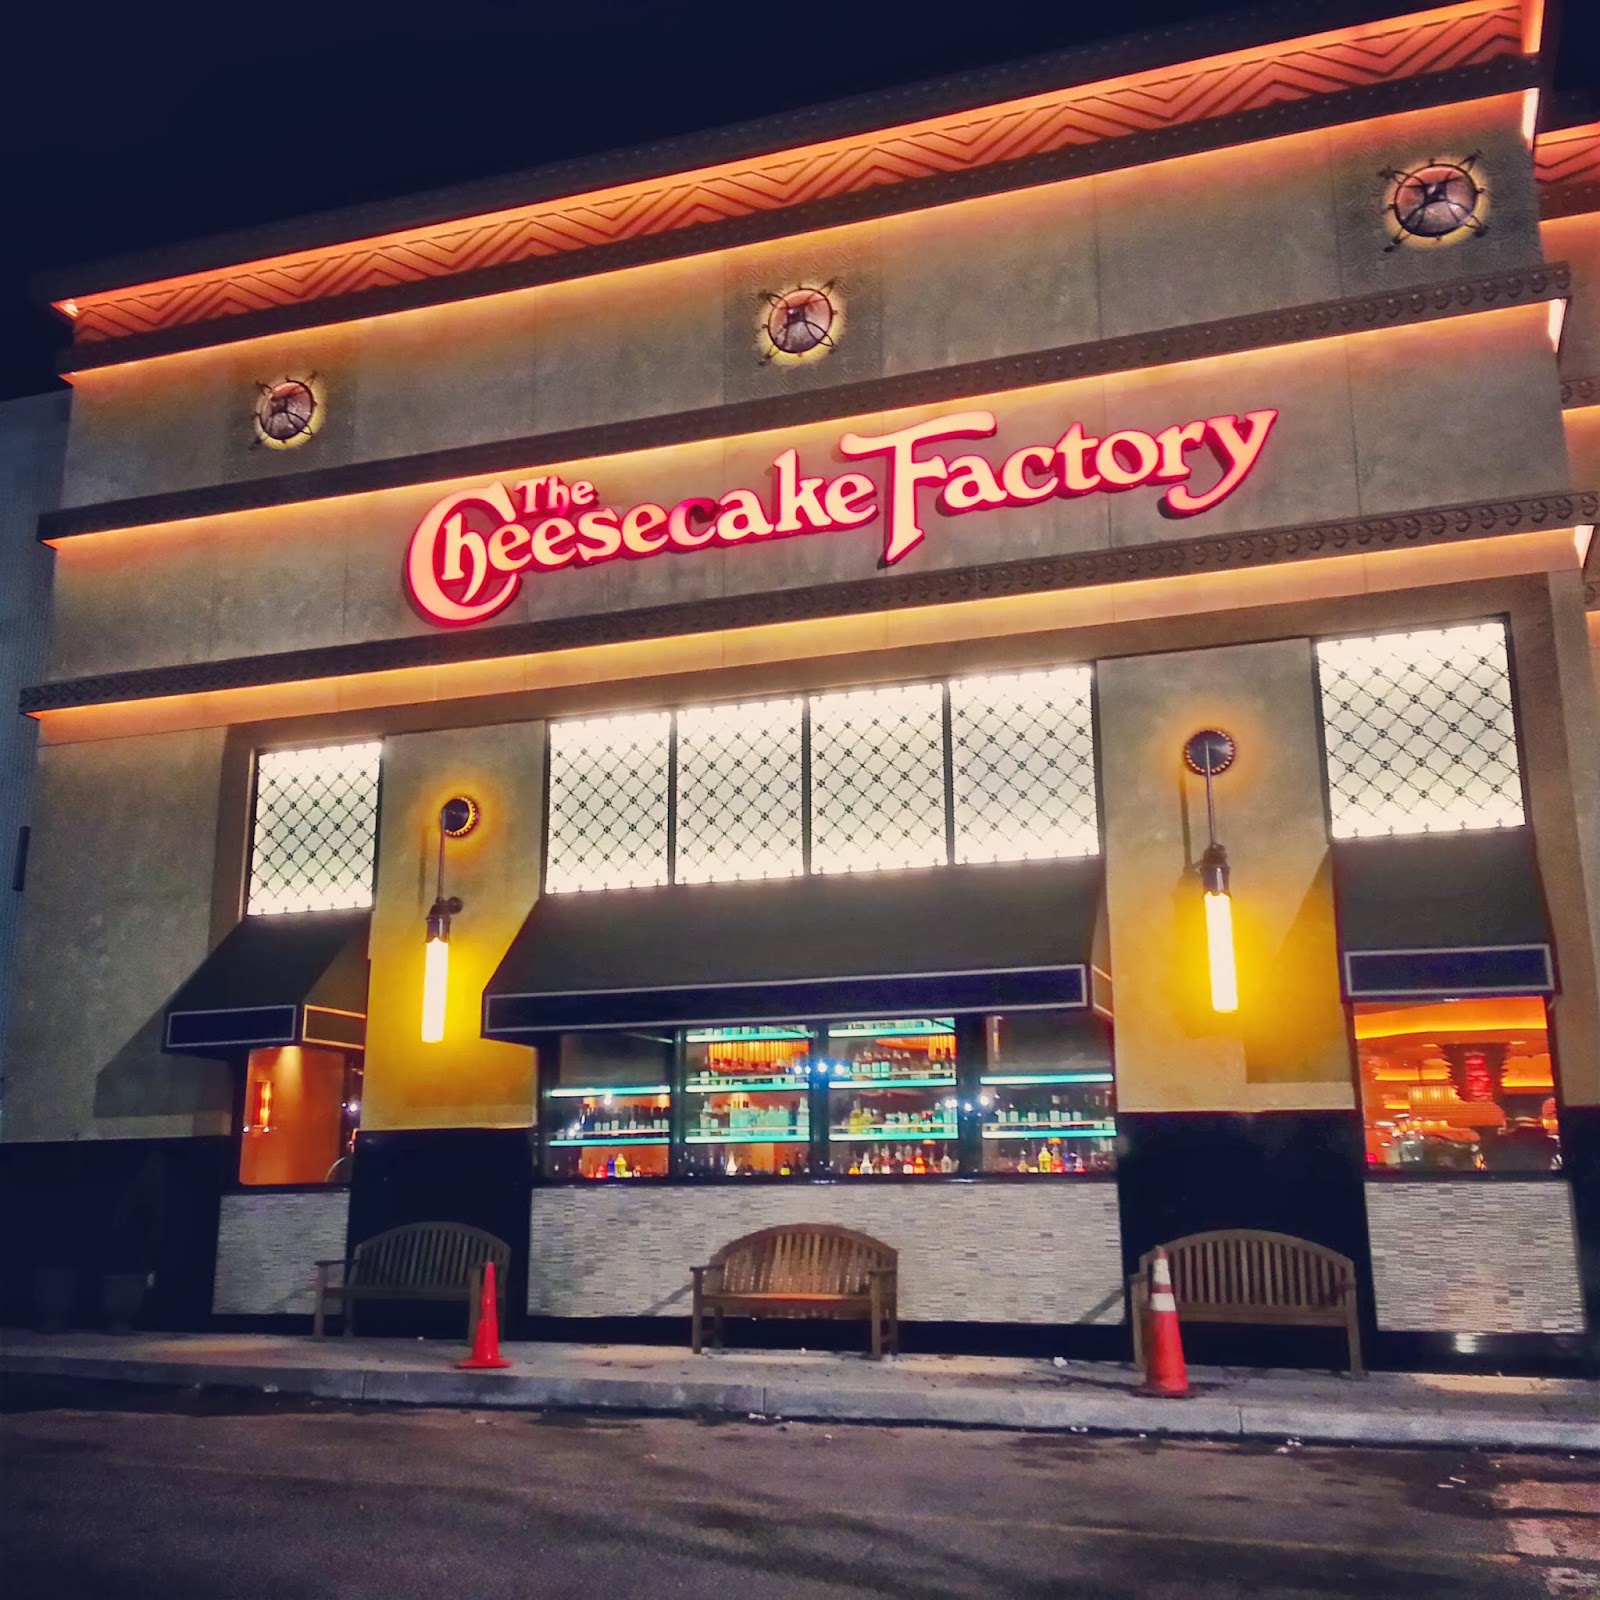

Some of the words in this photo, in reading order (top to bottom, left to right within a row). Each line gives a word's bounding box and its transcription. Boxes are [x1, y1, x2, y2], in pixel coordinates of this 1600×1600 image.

[407, 449, 878, 623] Cheesecake
[840, 409, 1278, 564] Factory
[515, 475, 597, 516] The
